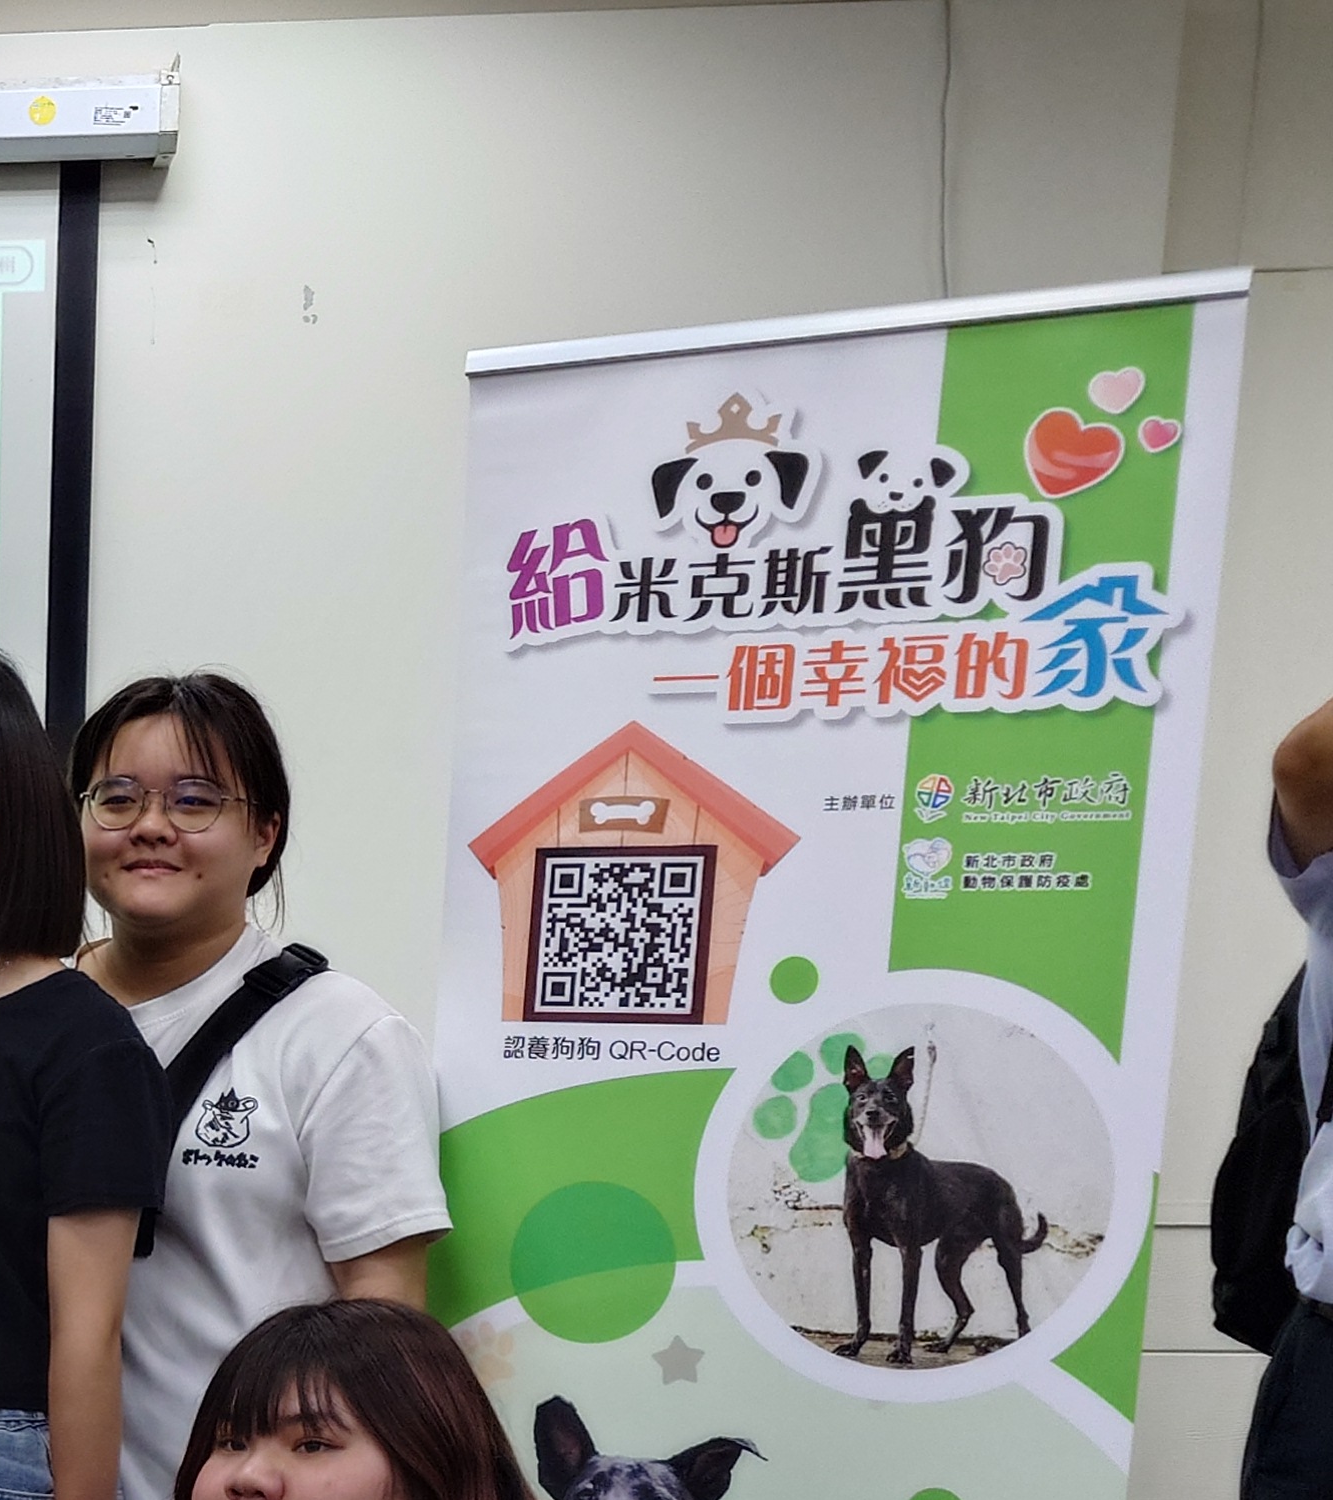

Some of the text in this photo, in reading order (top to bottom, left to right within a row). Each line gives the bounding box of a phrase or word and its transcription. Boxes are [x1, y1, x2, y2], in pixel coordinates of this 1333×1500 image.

[508, 503, 1050, 638] 給米克斯黑狗
[652, 575, 1167, 712] 一個幸福的家
[963, 773, 1131, 809] 新北市政府
[823, 794, 895, 811] 主辦單位
[964, 812, 987, 822] New
[964, 854, 1054, 869] 新北市政府
[962, 874, 1090, 890] 動物保護防疫處
[503, 1035, 721, 1062] 認養狗狗 QR-Code
